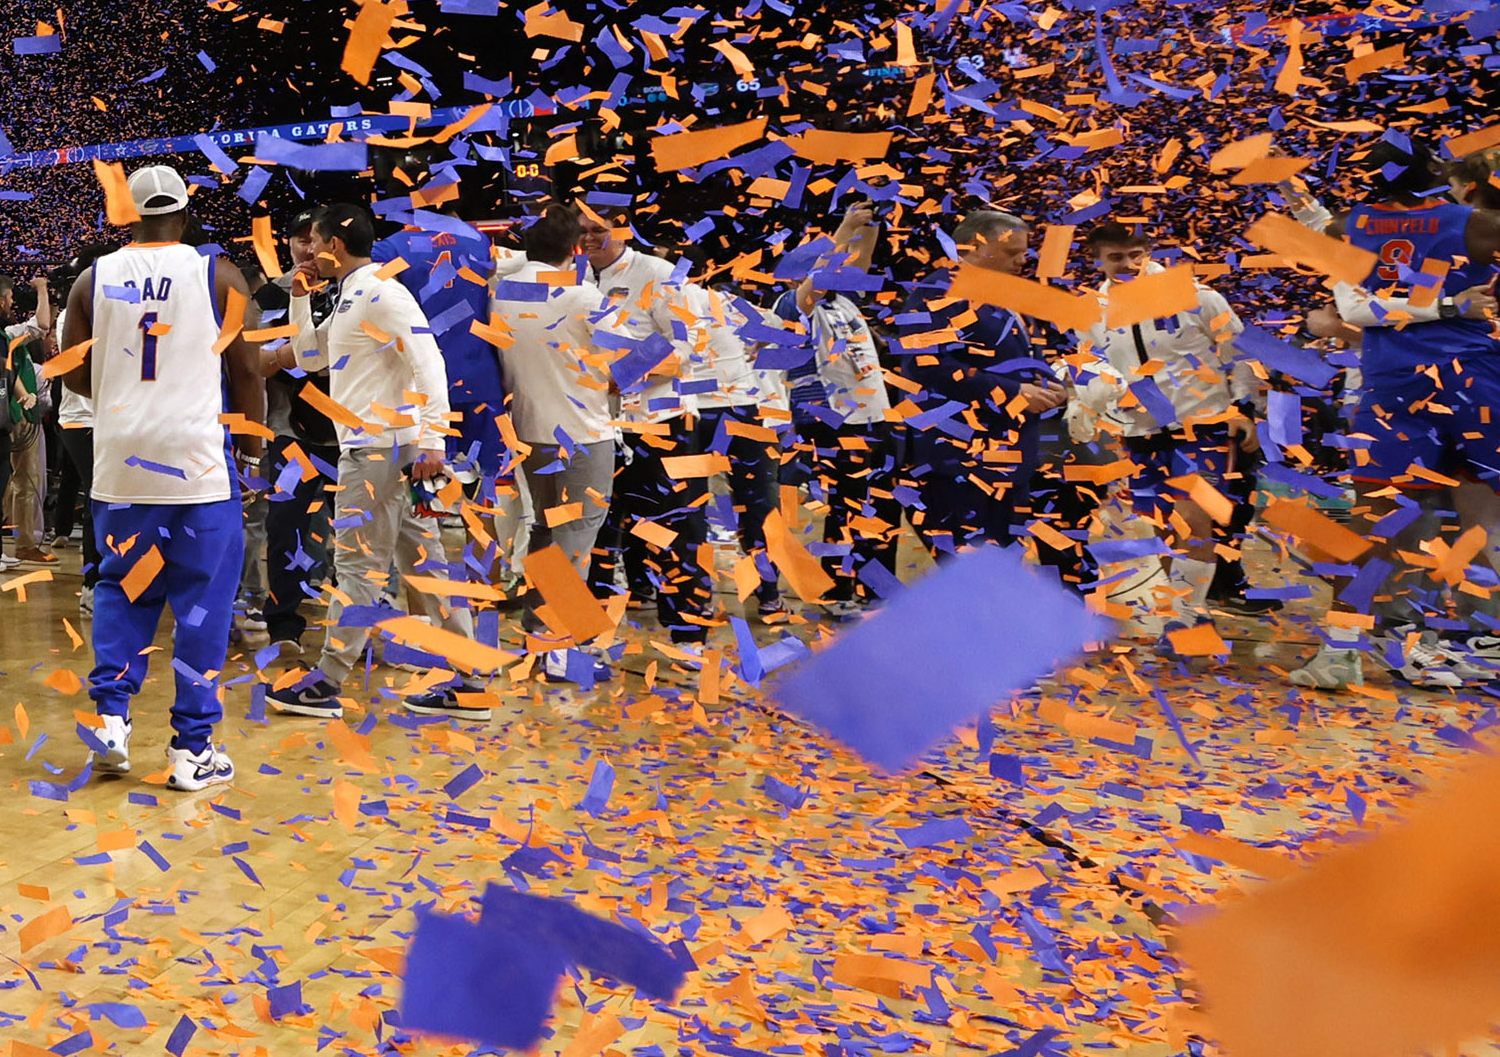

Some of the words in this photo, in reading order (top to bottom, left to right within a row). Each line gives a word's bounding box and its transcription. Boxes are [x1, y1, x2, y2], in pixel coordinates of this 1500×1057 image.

[736, 76, 760, 92] 65
[291, 118, 372, 138] GATRS
[516, 163, 539, 178] 0.0
[1377, 239, 1416, 281] 9
[138, 311, 159, 381] 1
